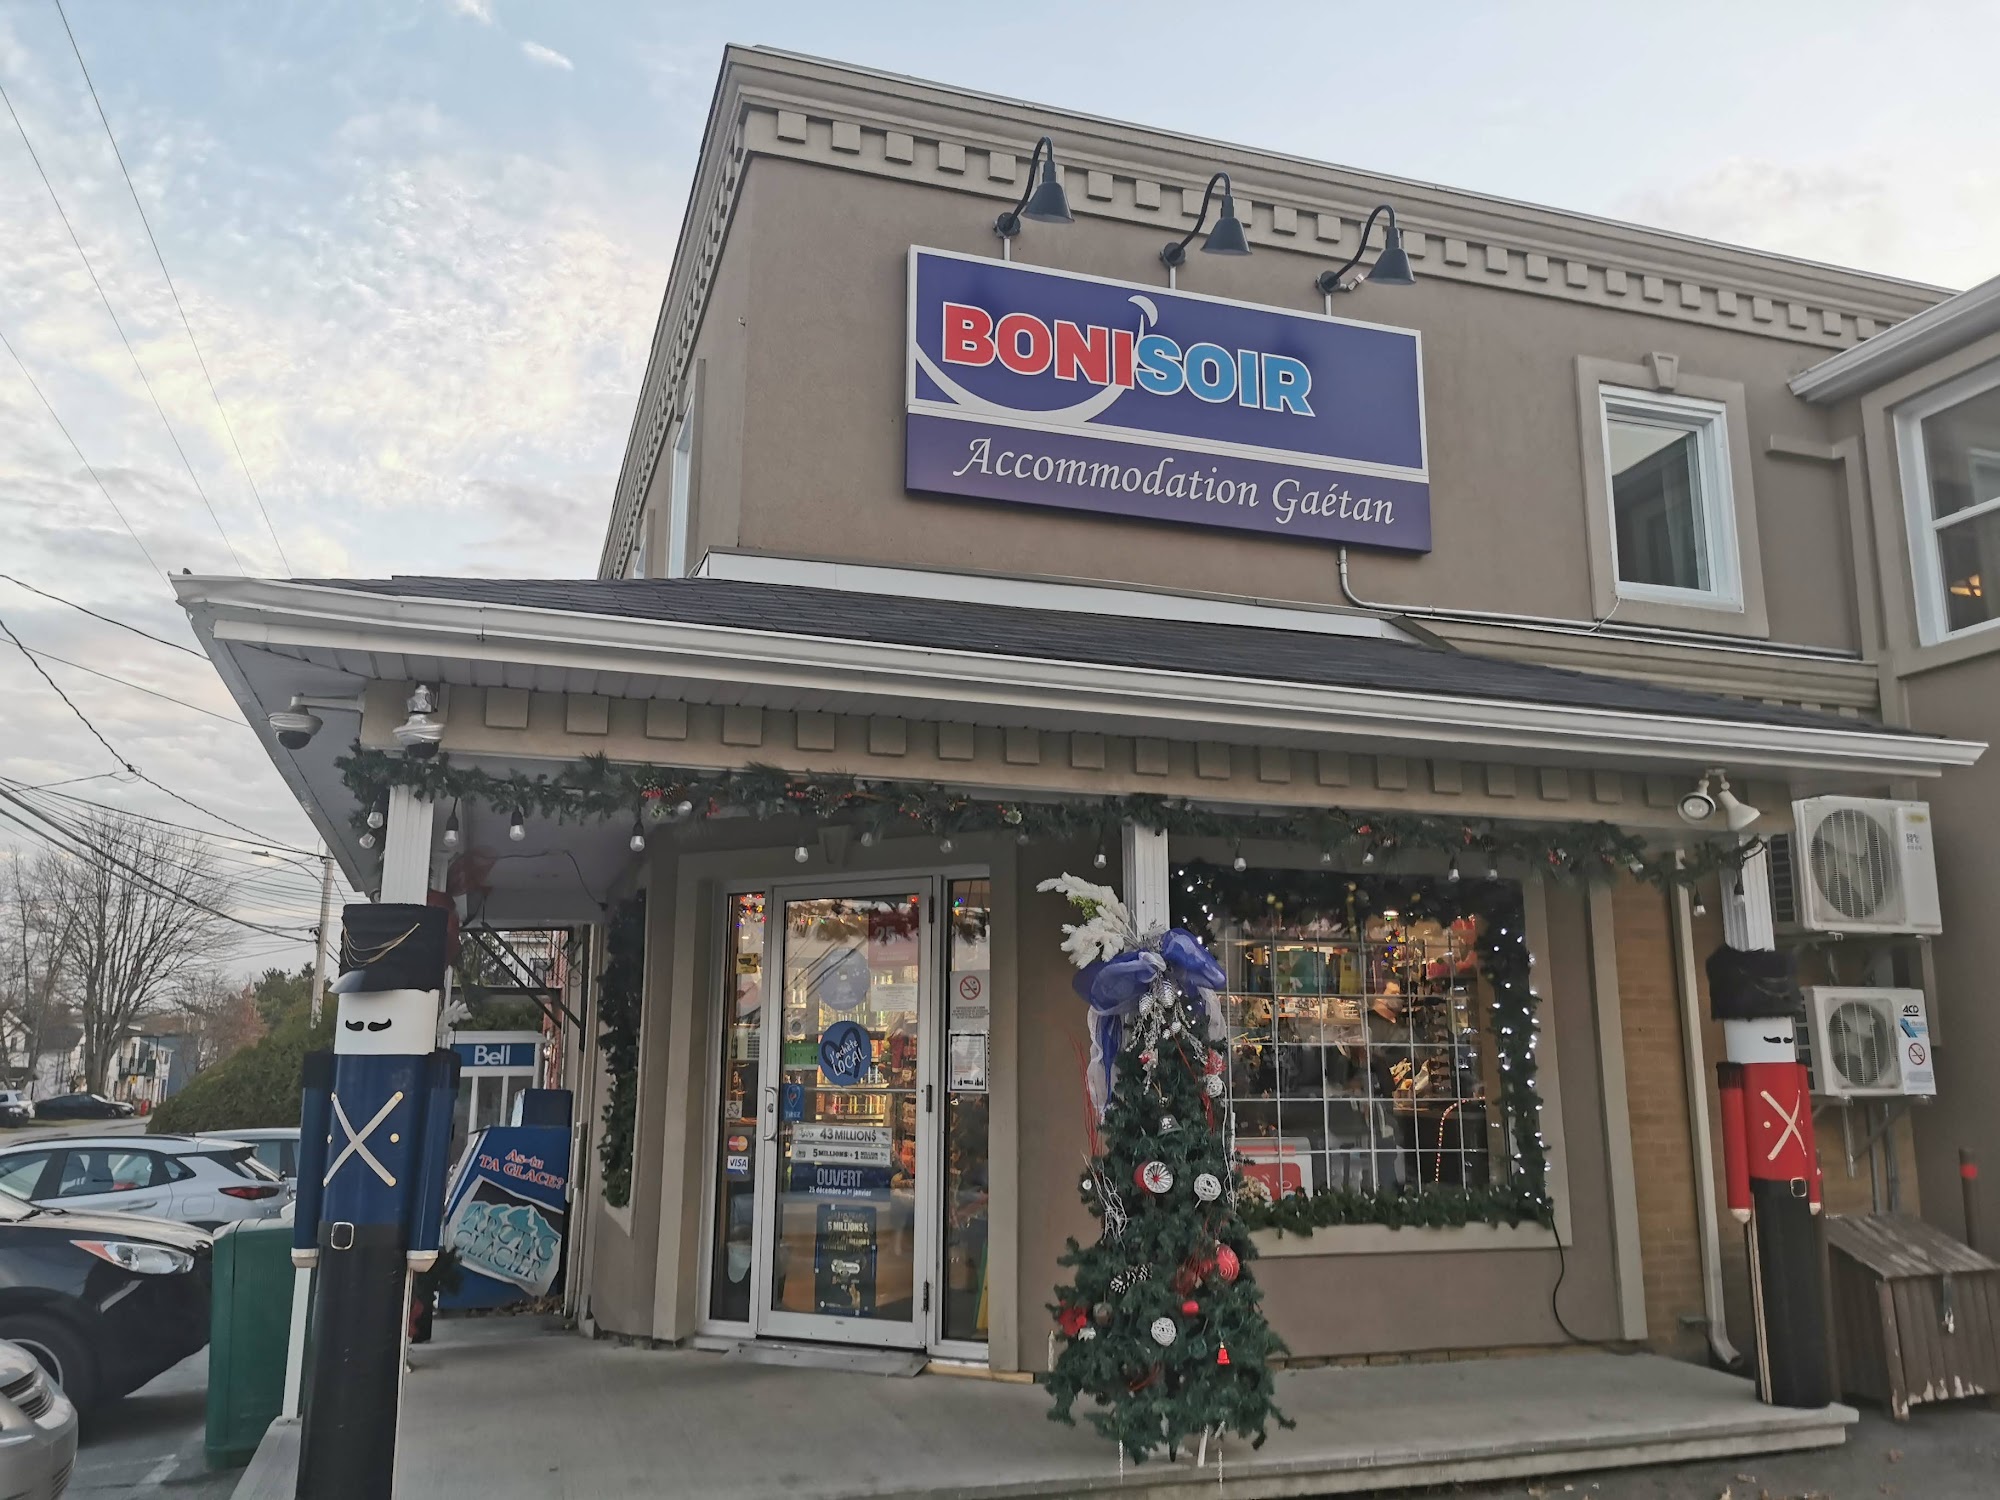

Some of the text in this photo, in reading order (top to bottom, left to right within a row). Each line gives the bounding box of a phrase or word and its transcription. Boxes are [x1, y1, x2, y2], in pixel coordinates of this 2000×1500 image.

[953, 437, 1395, 524] Accommodation Gaétan
[474, 1045, 510, 1065] Bell
[829, 1040, 859, 1064] J'achète
[832, 1048, 868, 1077] LOCAL
[820, 1128, 834, 1140] 43
[505, 1149, 544, 1170] As-tu
[730, 1159, 746, 1167] VISA
[813, 1148, 818, 1157] 5
[854, 1151, 859, 1159] 1
[479, 1154, 565, 1189] TA GLACE?
[816, 1167, 863, 1187] OUVERT
[852, 1188, 872, 1197] janvier
[462, 1206, 559, 1261] ARCTIC
[453, 1230, 542, 1281] GLACIER
